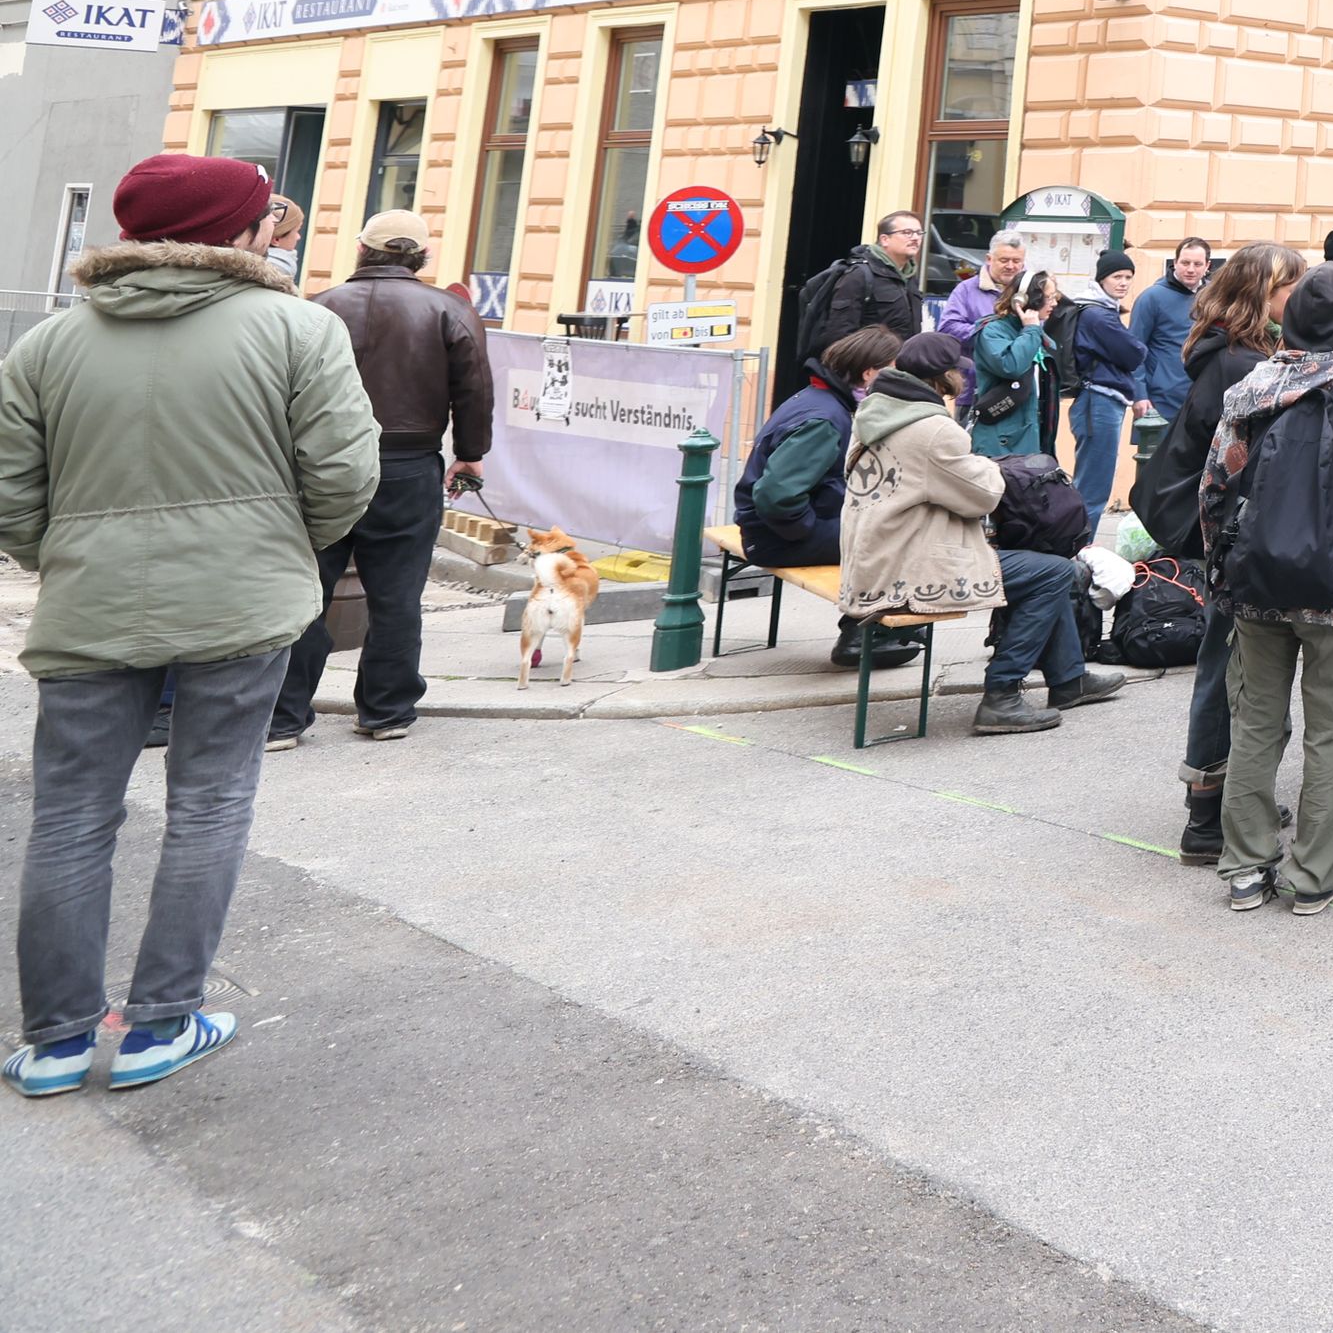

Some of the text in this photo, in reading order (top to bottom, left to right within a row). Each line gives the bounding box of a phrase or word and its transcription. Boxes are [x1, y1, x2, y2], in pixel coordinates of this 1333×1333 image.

[83, 4, 155, 29] IKAT
[256, 0, 288, 30] IKAT
[60, 32, 130, 42] RESTAURANT
[1055, 194, 1072, 206] IKAT
[609, 292, 633, 313] IKA
[652, 308, 685, 322] gilt ab
[651, 327, 709, 341] von bis
[575, 396, 607, 420] sucht
[610, 399, 697, 431] Verständnis.
